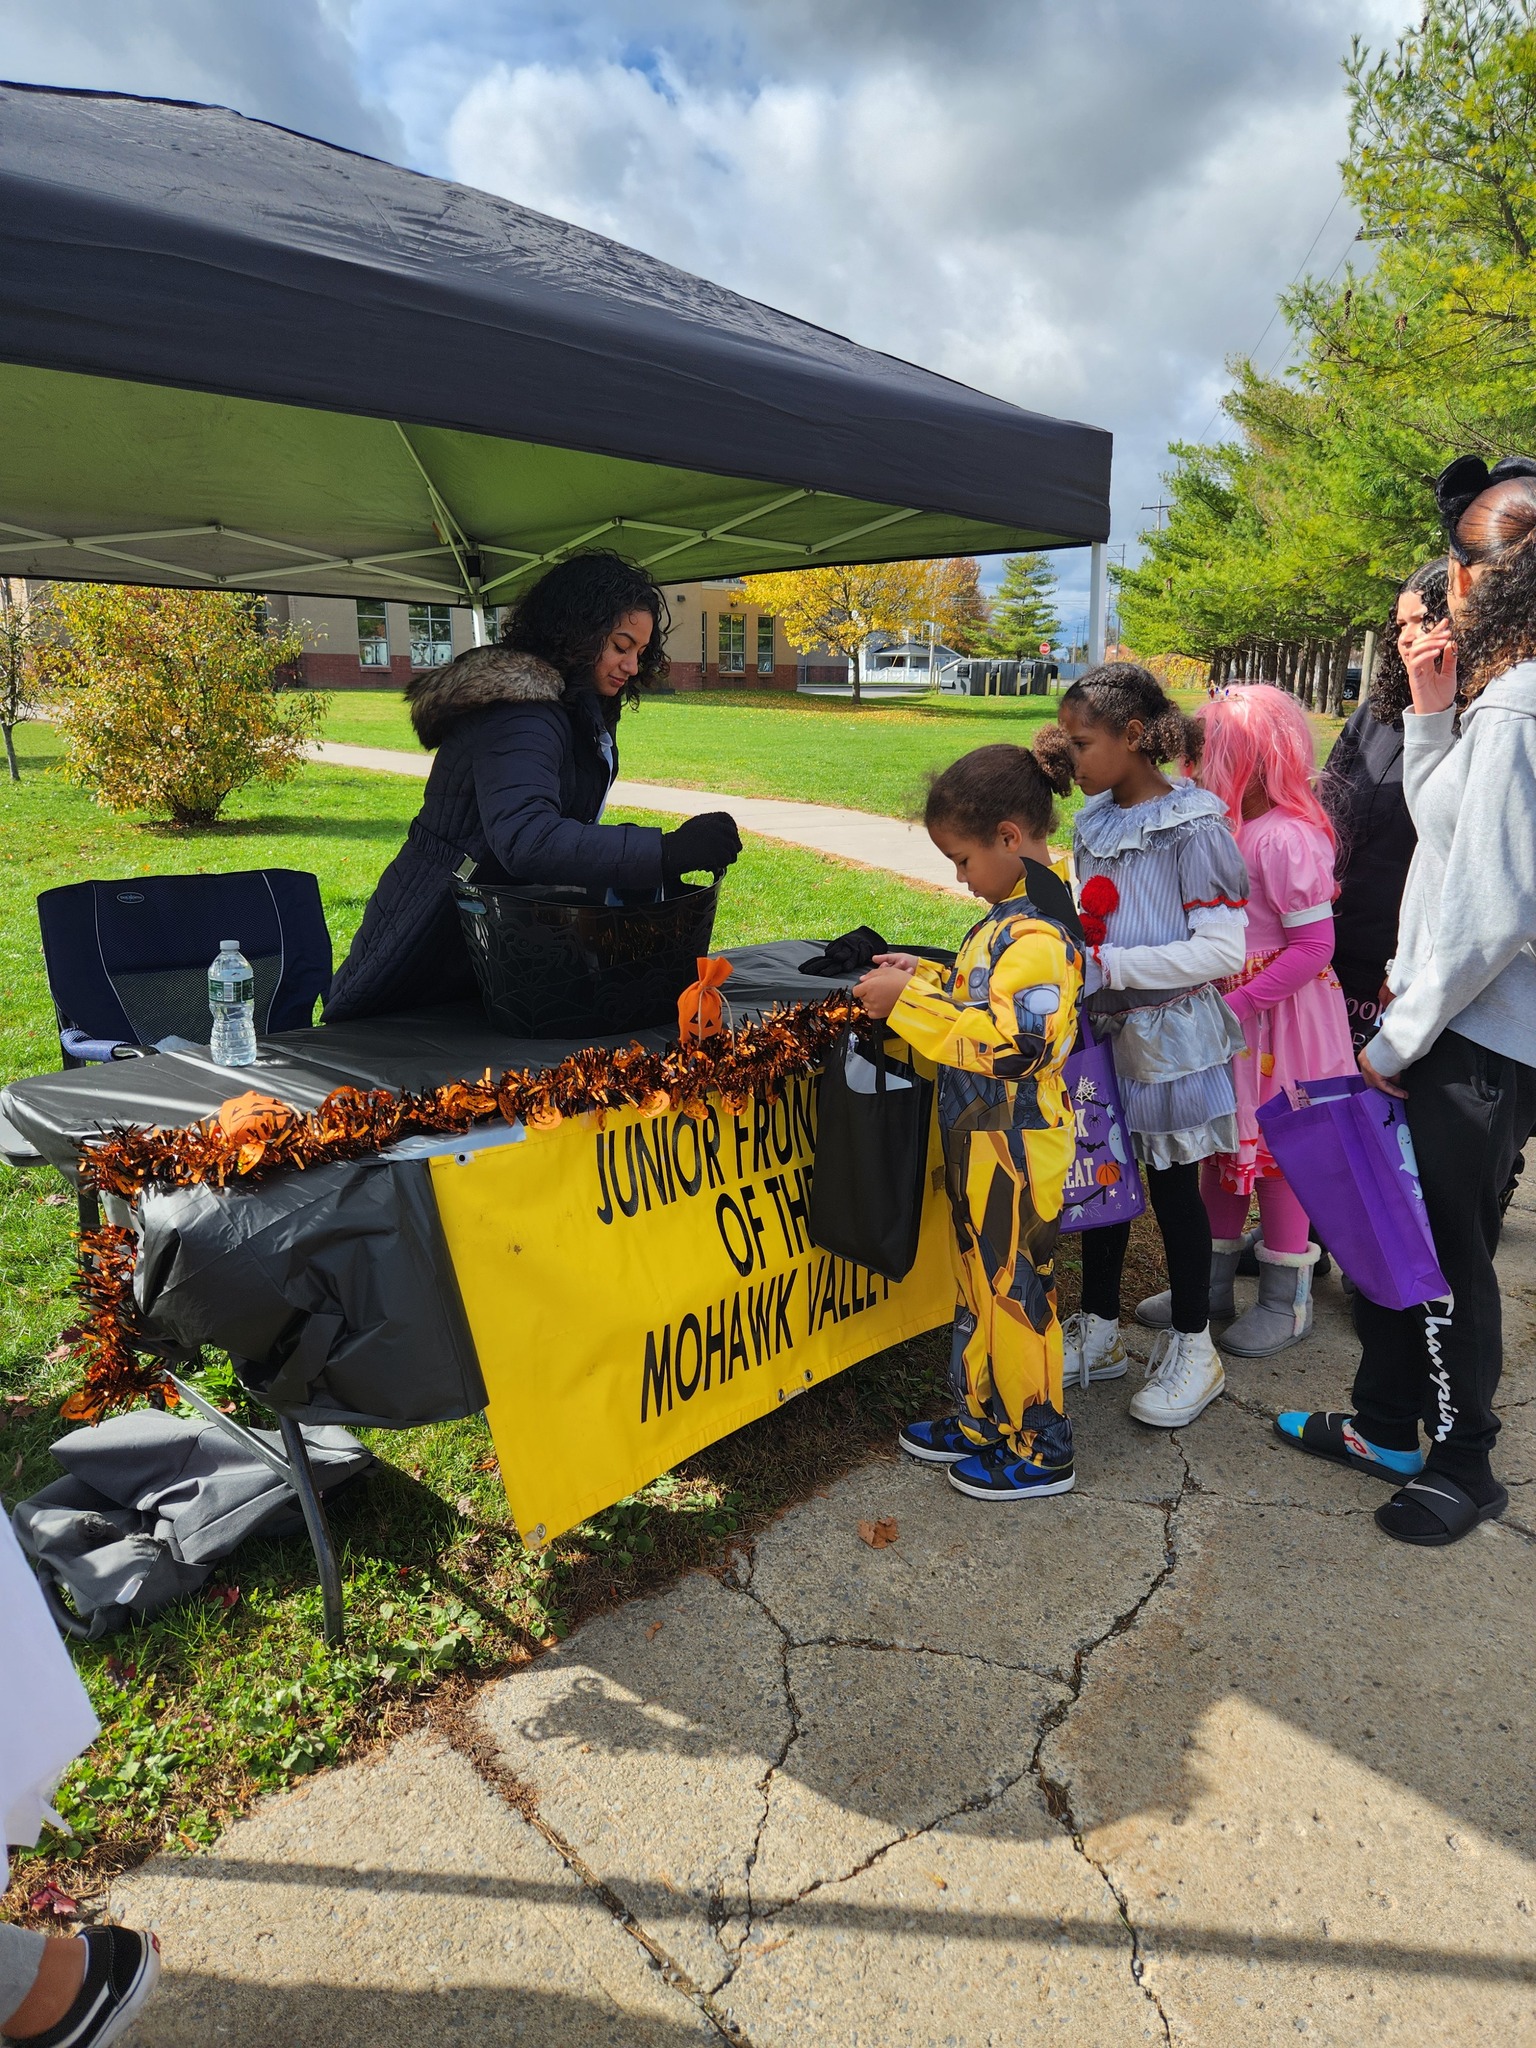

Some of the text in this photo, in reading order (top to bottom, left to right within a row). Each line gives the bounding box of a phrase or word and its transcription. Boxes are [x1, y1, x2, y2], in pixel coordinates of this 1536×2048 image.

[596, 1104, 725, 1224] JUNIOR
[1062, 1157, 1094, 1189] EAT
[715, 1184, 766, 1277] OF
[641, 1268, 798, 1424] MOHAWK
